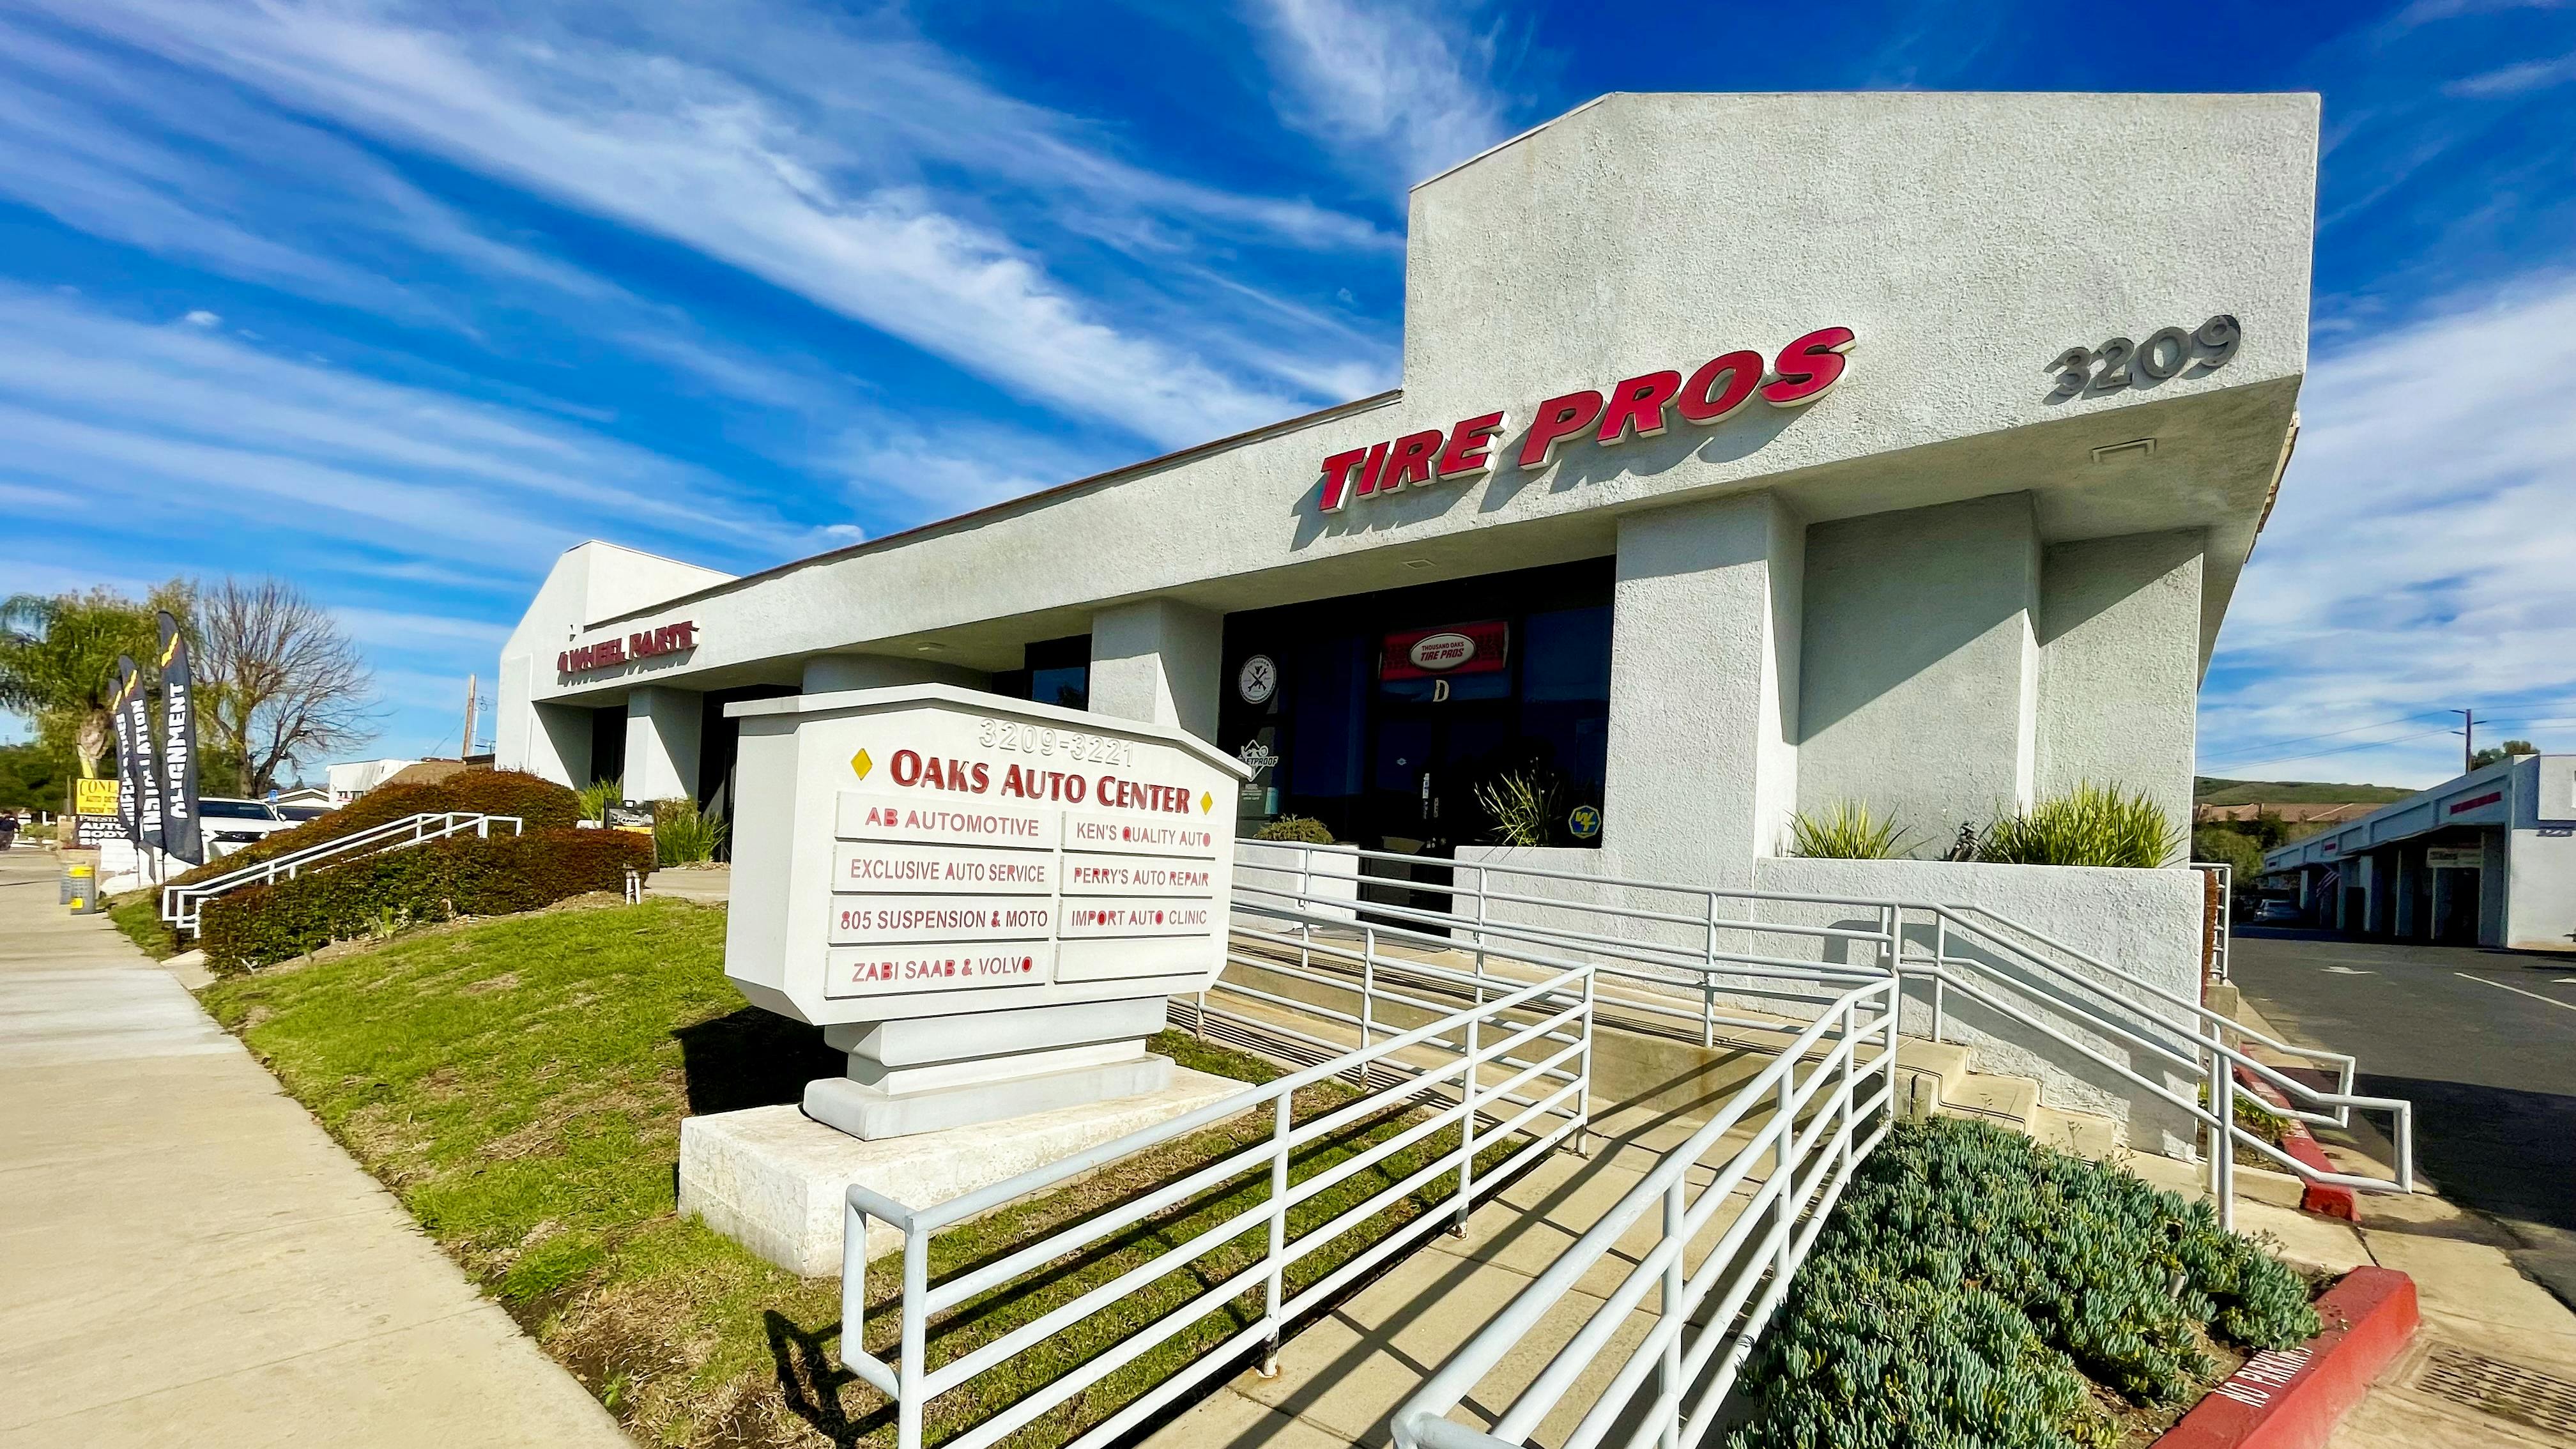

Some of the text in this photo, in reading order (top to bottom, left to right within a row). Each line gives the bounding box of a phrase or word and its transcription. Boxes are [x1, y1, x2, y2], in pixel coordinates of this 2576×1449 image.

[2043, 314, 2241, 397] 3209
[1319, 326, 1855, 513] TIRE PROS
[570, 638, 629, 671] WHEEL
[629, 620, 700, 659] PARTS
[1420, 648, 1464, 661] TIRE PROS
[1422, 643, 1450, 651] THOUSAND
[1433, 679, 1450, 702] D
[166, 683, 188, 819] ALIGNMENT
[979, 718, 1134, 767] 3209-3221
[890, 749, 1190, 813] OAKS AUTO CENTER
[79, 830, 129, 838] BODY
[865, 807, 1039, 836] AB AUTOMOTIVE
[1077, 822, 1211, 847] KEN'S QUALITY AUTO
[851, 859, 1045, 882] EXCLUSIVE AUTO SERVICE
[1074, 867, 1209, 886] PERRY'S AUTO REPAIR
[841, 910, 1048, 930] 805 SUSPENSION & MOTO
[1071, 909, 1207, 926] IMPORT AUTO CLINIC
[852, 956, 1032, 983] ZABI SAAB & VOLVO
[2214, 1381, 2272, 1408] NO
